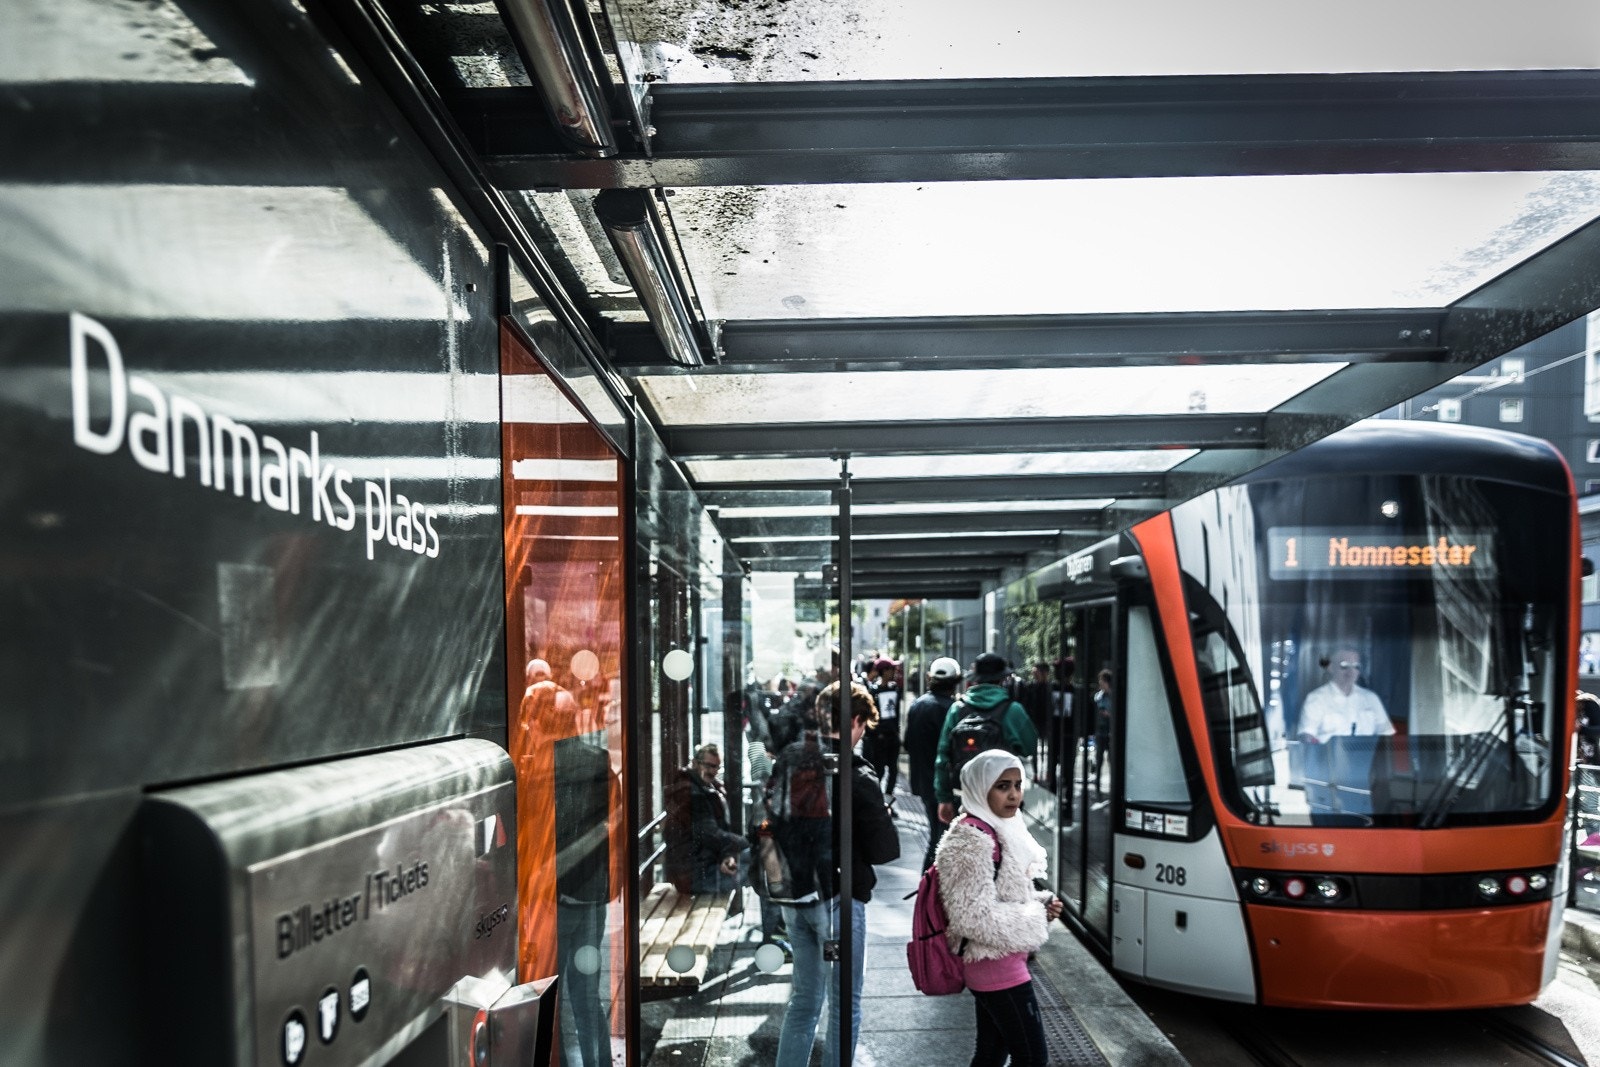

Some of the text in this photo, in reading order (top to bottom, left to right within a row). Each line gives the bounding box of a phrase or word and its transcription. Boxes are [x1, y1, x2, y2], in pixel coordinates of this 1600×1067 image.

[70, 311, 440, 561] Danmarks plass
[1284, 536, 1477, 567] 1 Nonneseter
[1155, 862, 1187, 887] 208
[276, 893, 361, 960] Billetter
[373, 861, 429, 909] Tickets
